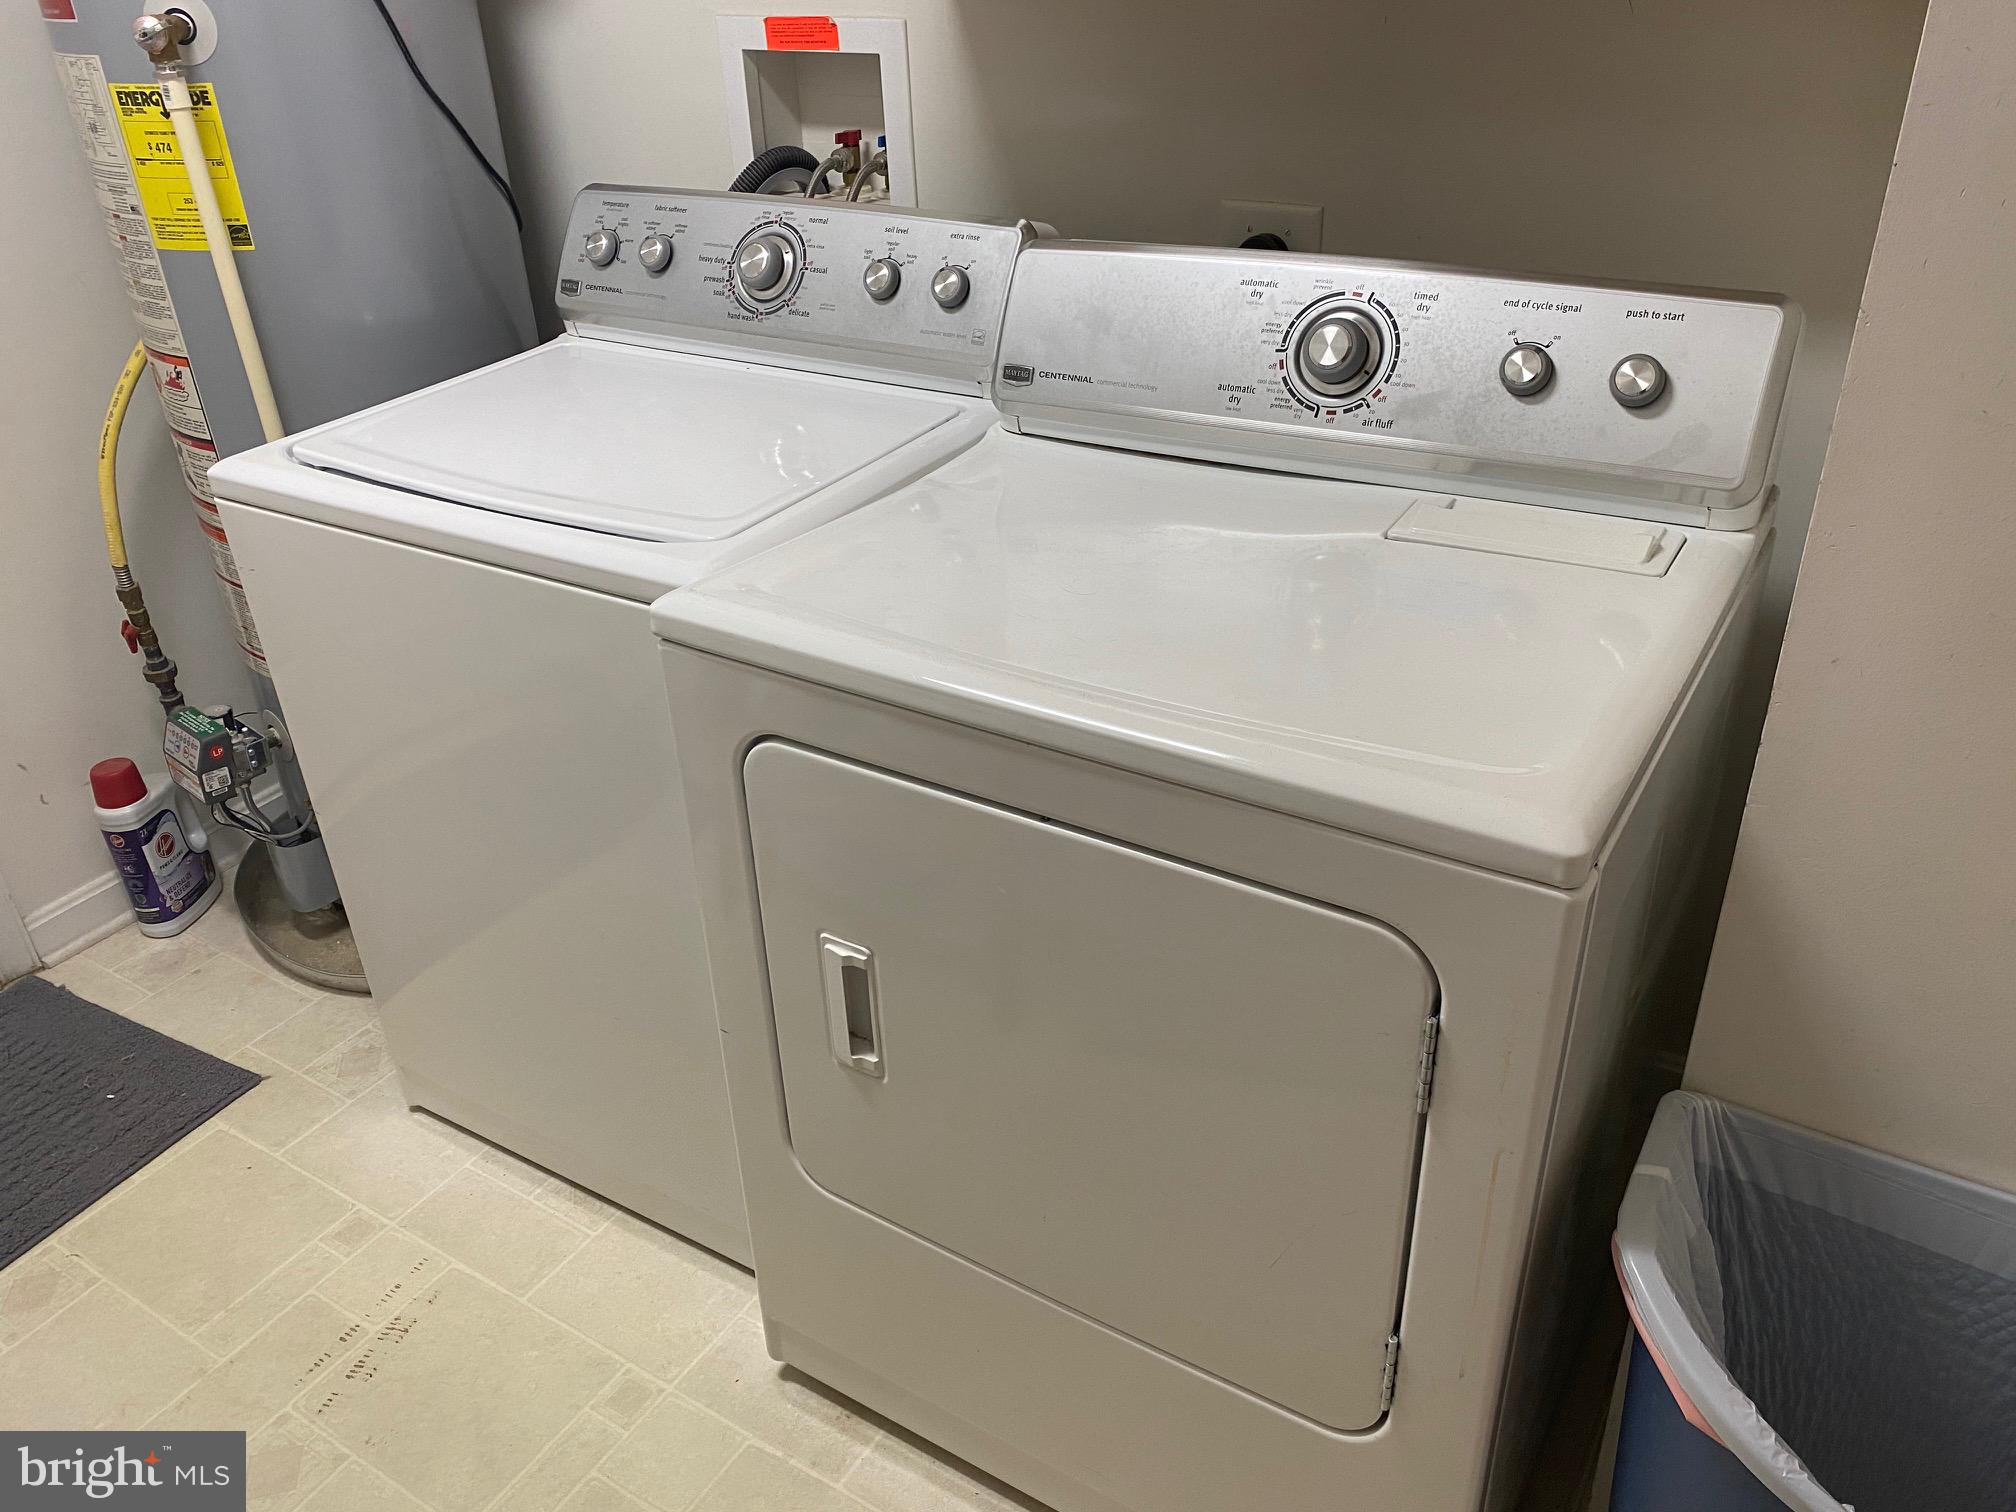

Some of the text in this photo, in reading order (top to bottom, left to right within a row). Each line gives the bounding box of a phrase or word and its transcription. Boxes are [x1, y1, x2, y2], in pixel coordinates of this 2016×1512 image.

[116, 90, 211, 108] ENERGYDE
[155, 142, 172, 153] 474
[602, 200, 629, 209] temperature
[654, 204, 688, 214] fabric softener
[895, 227, 909, 235] level
[699, 255, 727, 266] heavy duty
[703, 275, 725, 283] prewash
[1240, 279, 1279, 289] automatic
[585, 284, 623, 294] CENTENNIAL
[1250, 289, 1264, 299] dry
[1413, 291, 1439, 301] timed
[1416, 303, 1431, 314] dry
[1503, 299, 1582, 314] end of cycle signal
[788, 309, 810, 318] delicate
[1625, 309, 1685, 322] push to start
[1268, 362, 1278, 370] off
[1038, 371, 1158, 392] CENTENNIAL commercial technology
[1217, 383, 1256, 394] automatic
[1228, 395, 1242, 405] dry
[1378, 395, 1387, 403] off
[1270, 403, 1293, 411] preferred
[1362, 418, 1394, 429] air fluff
[212, 748, 223, 757] LP
